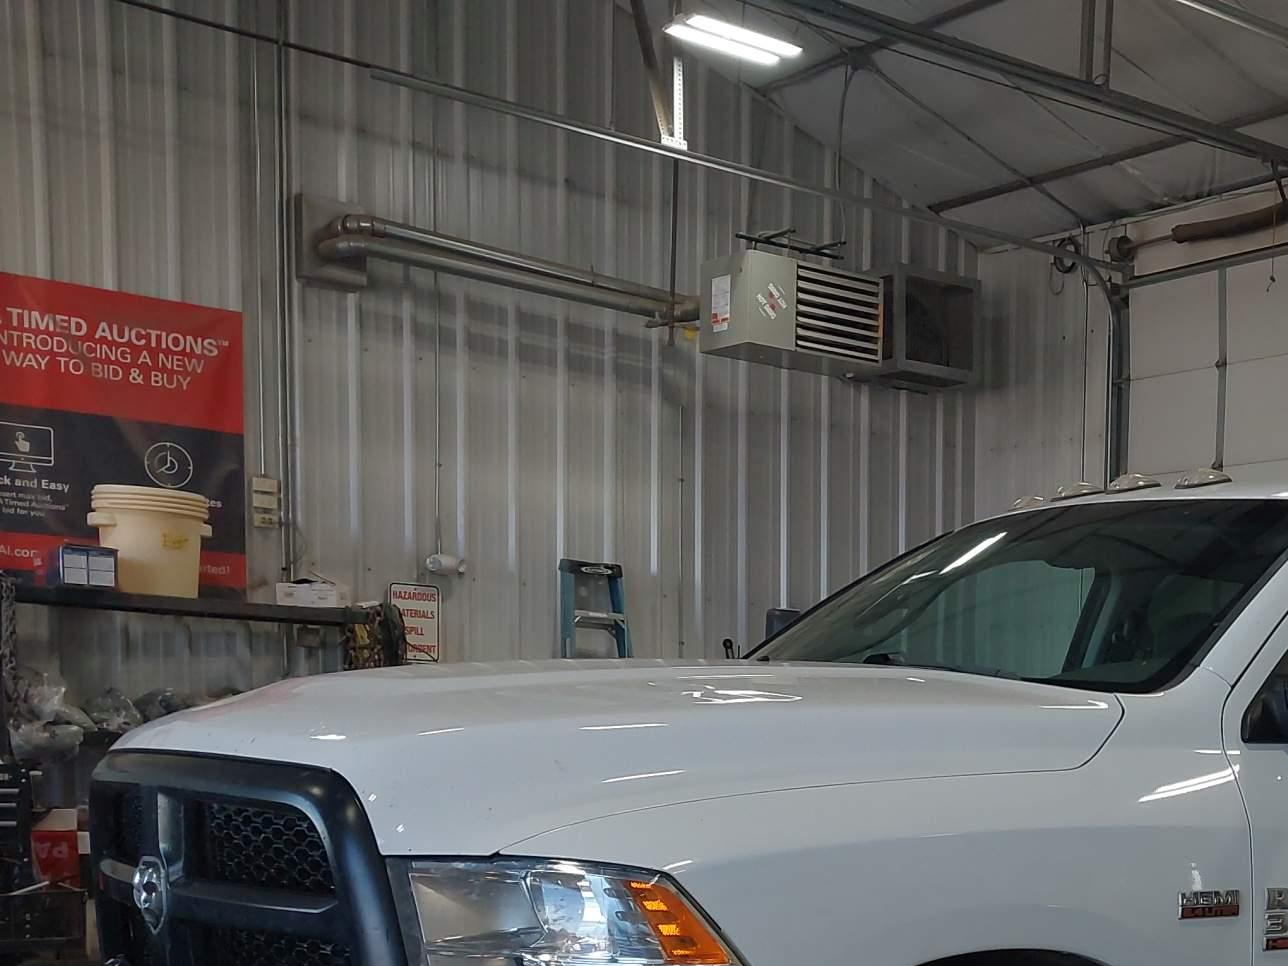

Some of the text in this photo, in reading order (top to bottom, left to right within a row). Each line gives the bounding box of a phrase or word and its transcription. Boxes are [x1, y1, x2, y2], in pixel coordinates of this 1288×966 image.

[6, 307, 87, 336] TIMED
[2, 349, 192, 391] WAY TO BID & BUY
[138, 350, 152, 366] A
[159, 353, 205, 374] NEW
[15, 478, 38, 489] and
[41, 479, 70, 494] Easy
[392, 590, 437, 602] HAZARDOUS
[401, 608, 435, 620] ATERIALS
[1182, 890, 1240, 905] HEMI
